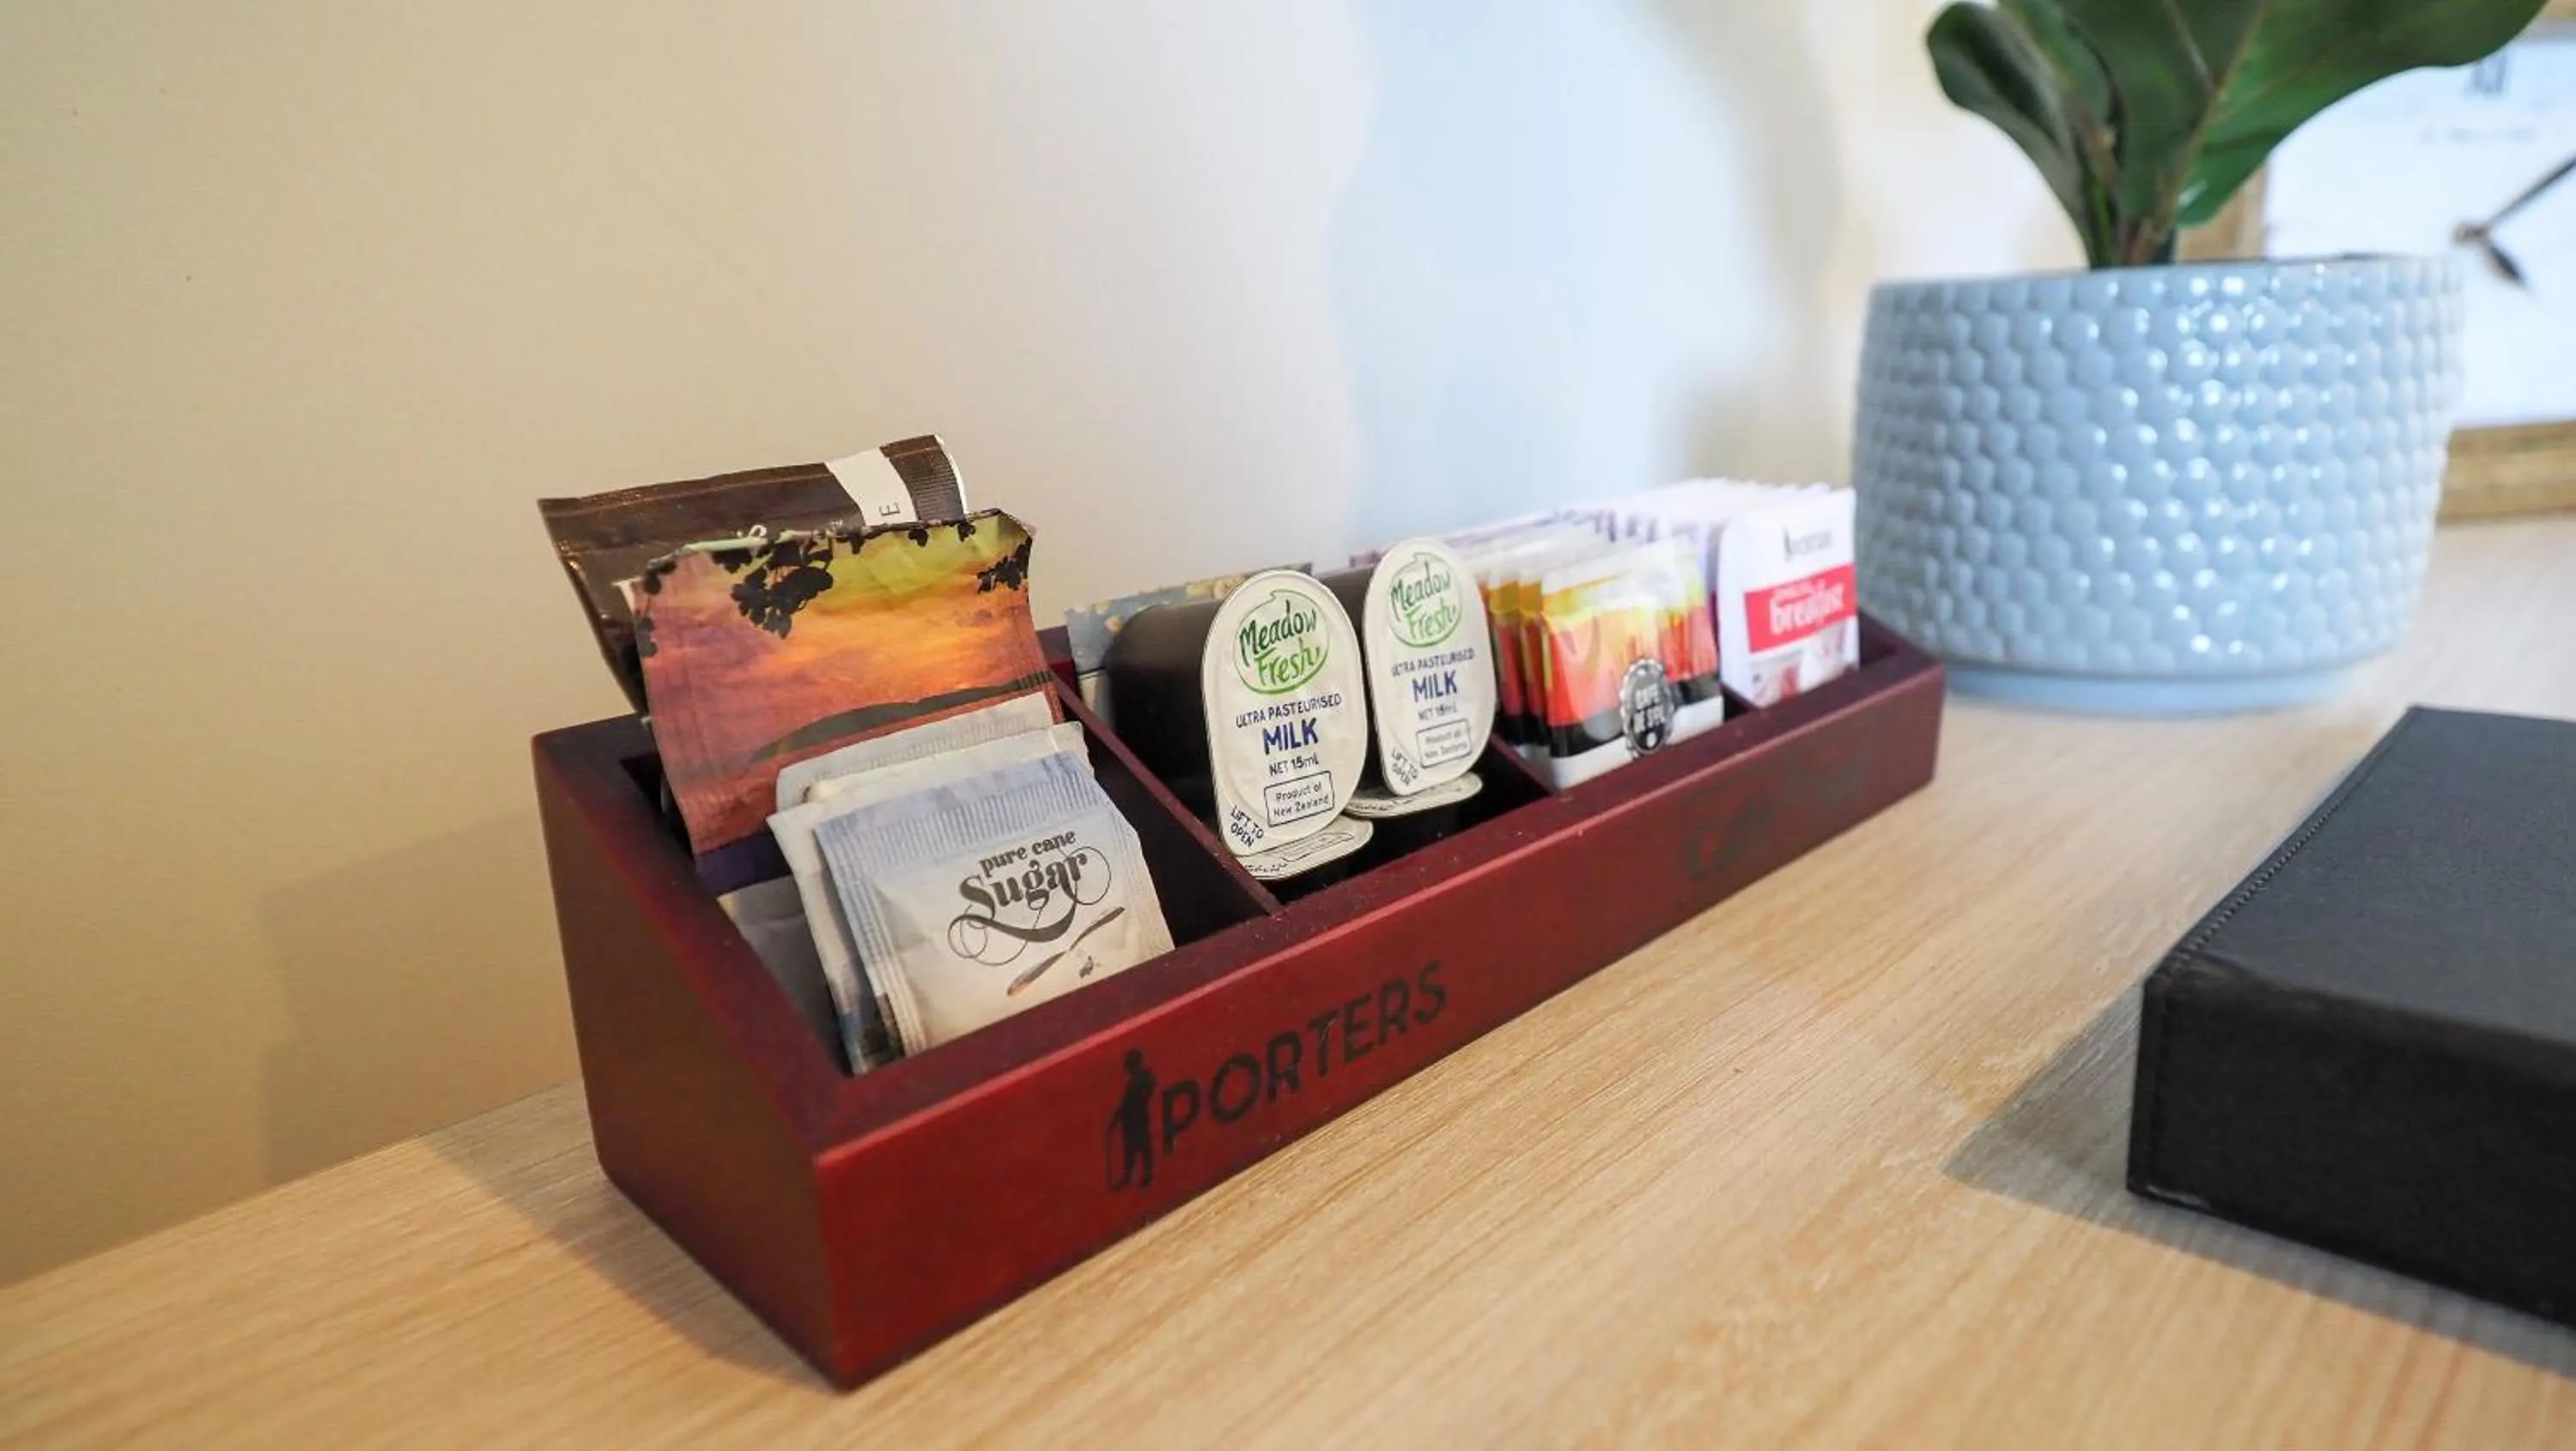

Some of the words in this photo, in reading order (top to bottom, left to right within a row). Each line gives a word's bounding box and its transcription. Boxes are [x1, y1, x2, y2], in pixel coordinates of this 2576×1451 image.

[1391, 560, 1450, 622] Meadow
[1239, 598, 1316, 667] Meadow
[1405, 596, 1453, 640] Fresh
[1254, 636, 1317, 686] Fresh
[1391, 661, 1415, 677] ULTRA
[1412, 670, 1457, 702] MILK
[1236, 708, 1266, 728] ULTRA
[1268, 693, 1342, 720] PASTEURISED
[1262, 717, 1318, 756] MILK
[1269, 760, 1288, 776] NET
[1273, 805, 1292, 817] New
[1295, 795, 1329, 811] Zealand
[1276, 785, 1311, 803] Product
[1314, 782, 1322, 793] of
[1230, 804, 1251, 828] LIFT
[1251, 823, 1264, 840] TO
[1230, 823, 1255, 847] OPEN
[978, 845, 1026, 878] pure
[1032, 831, 1076, 857] cane
[950, 849, 1092, 942] Sugar
[1162, 959, 1448, 1159] PORTERS
